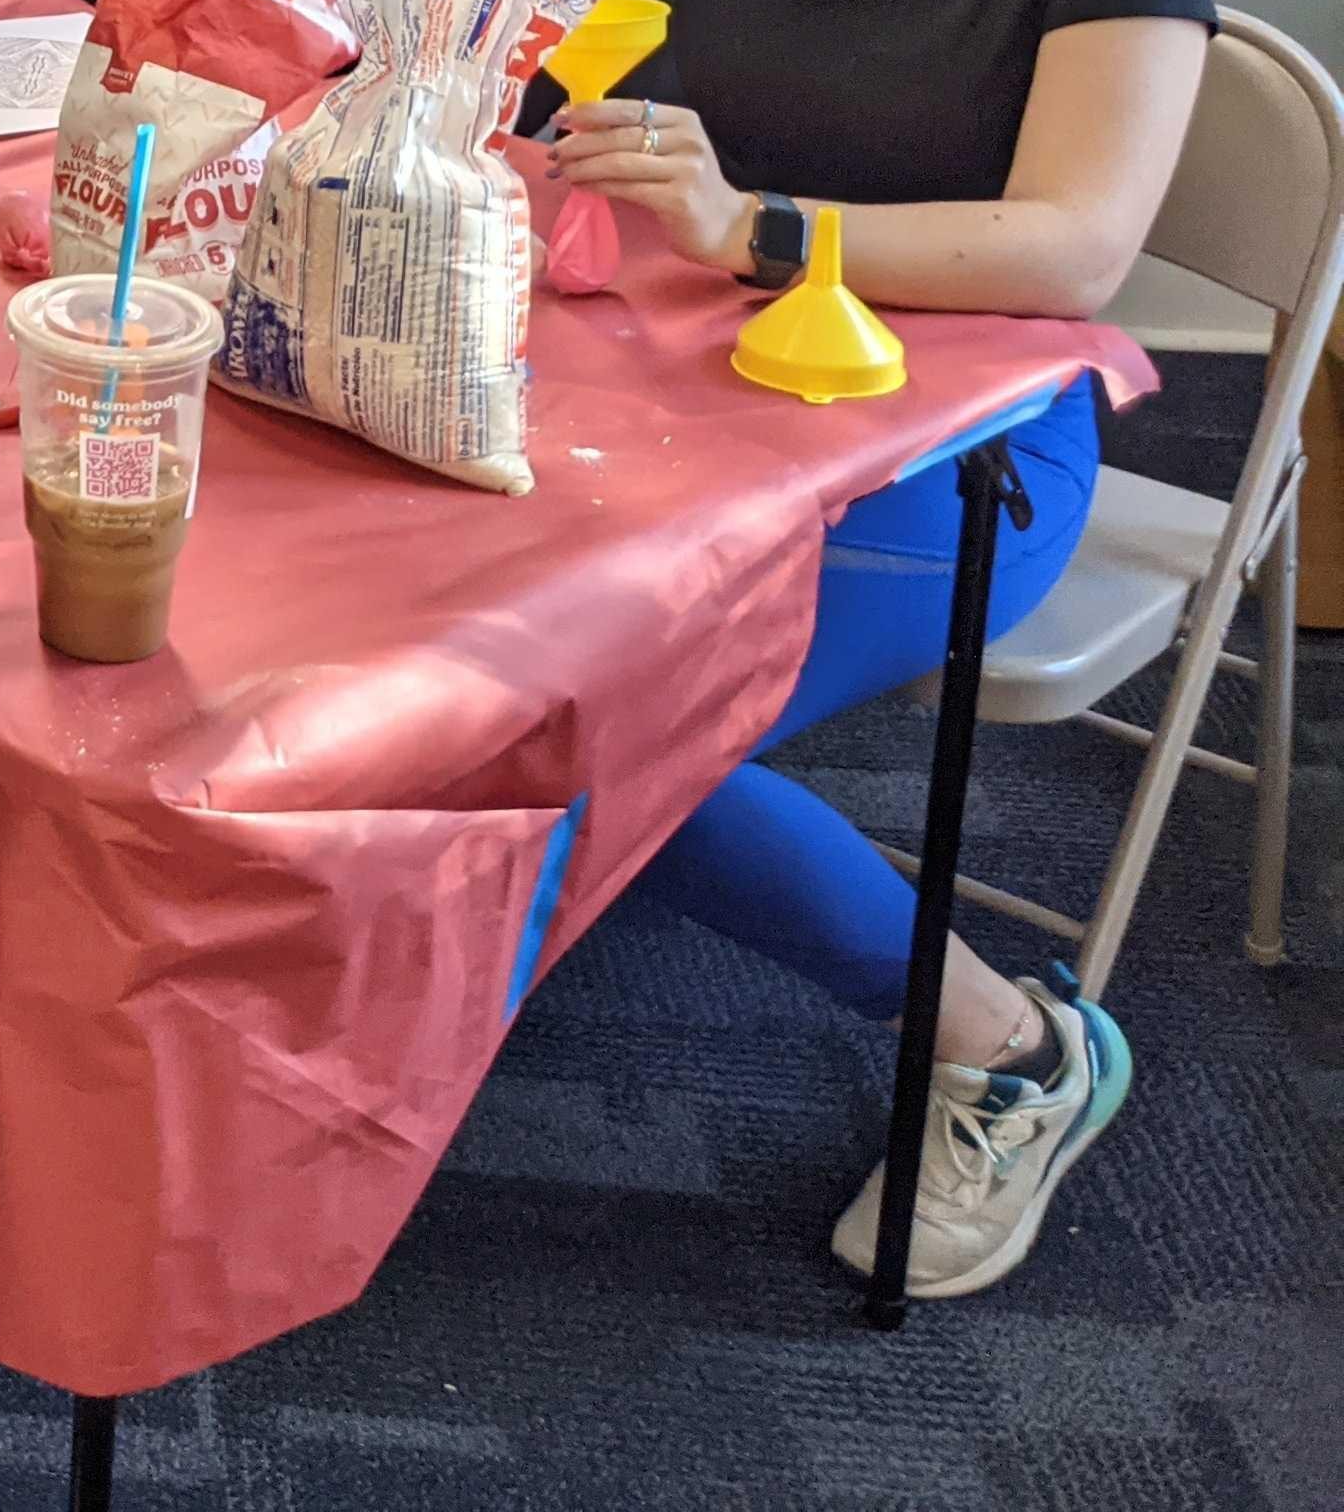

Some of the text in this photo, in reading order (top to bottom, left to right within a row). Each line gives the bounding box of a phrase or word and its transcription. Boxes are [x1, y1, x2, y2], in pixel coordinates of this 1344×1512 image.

[55, 173, 127, 225] FLOUR
[56, 389, 88, 408] Did
[79, 413, 161, 428] say free?
